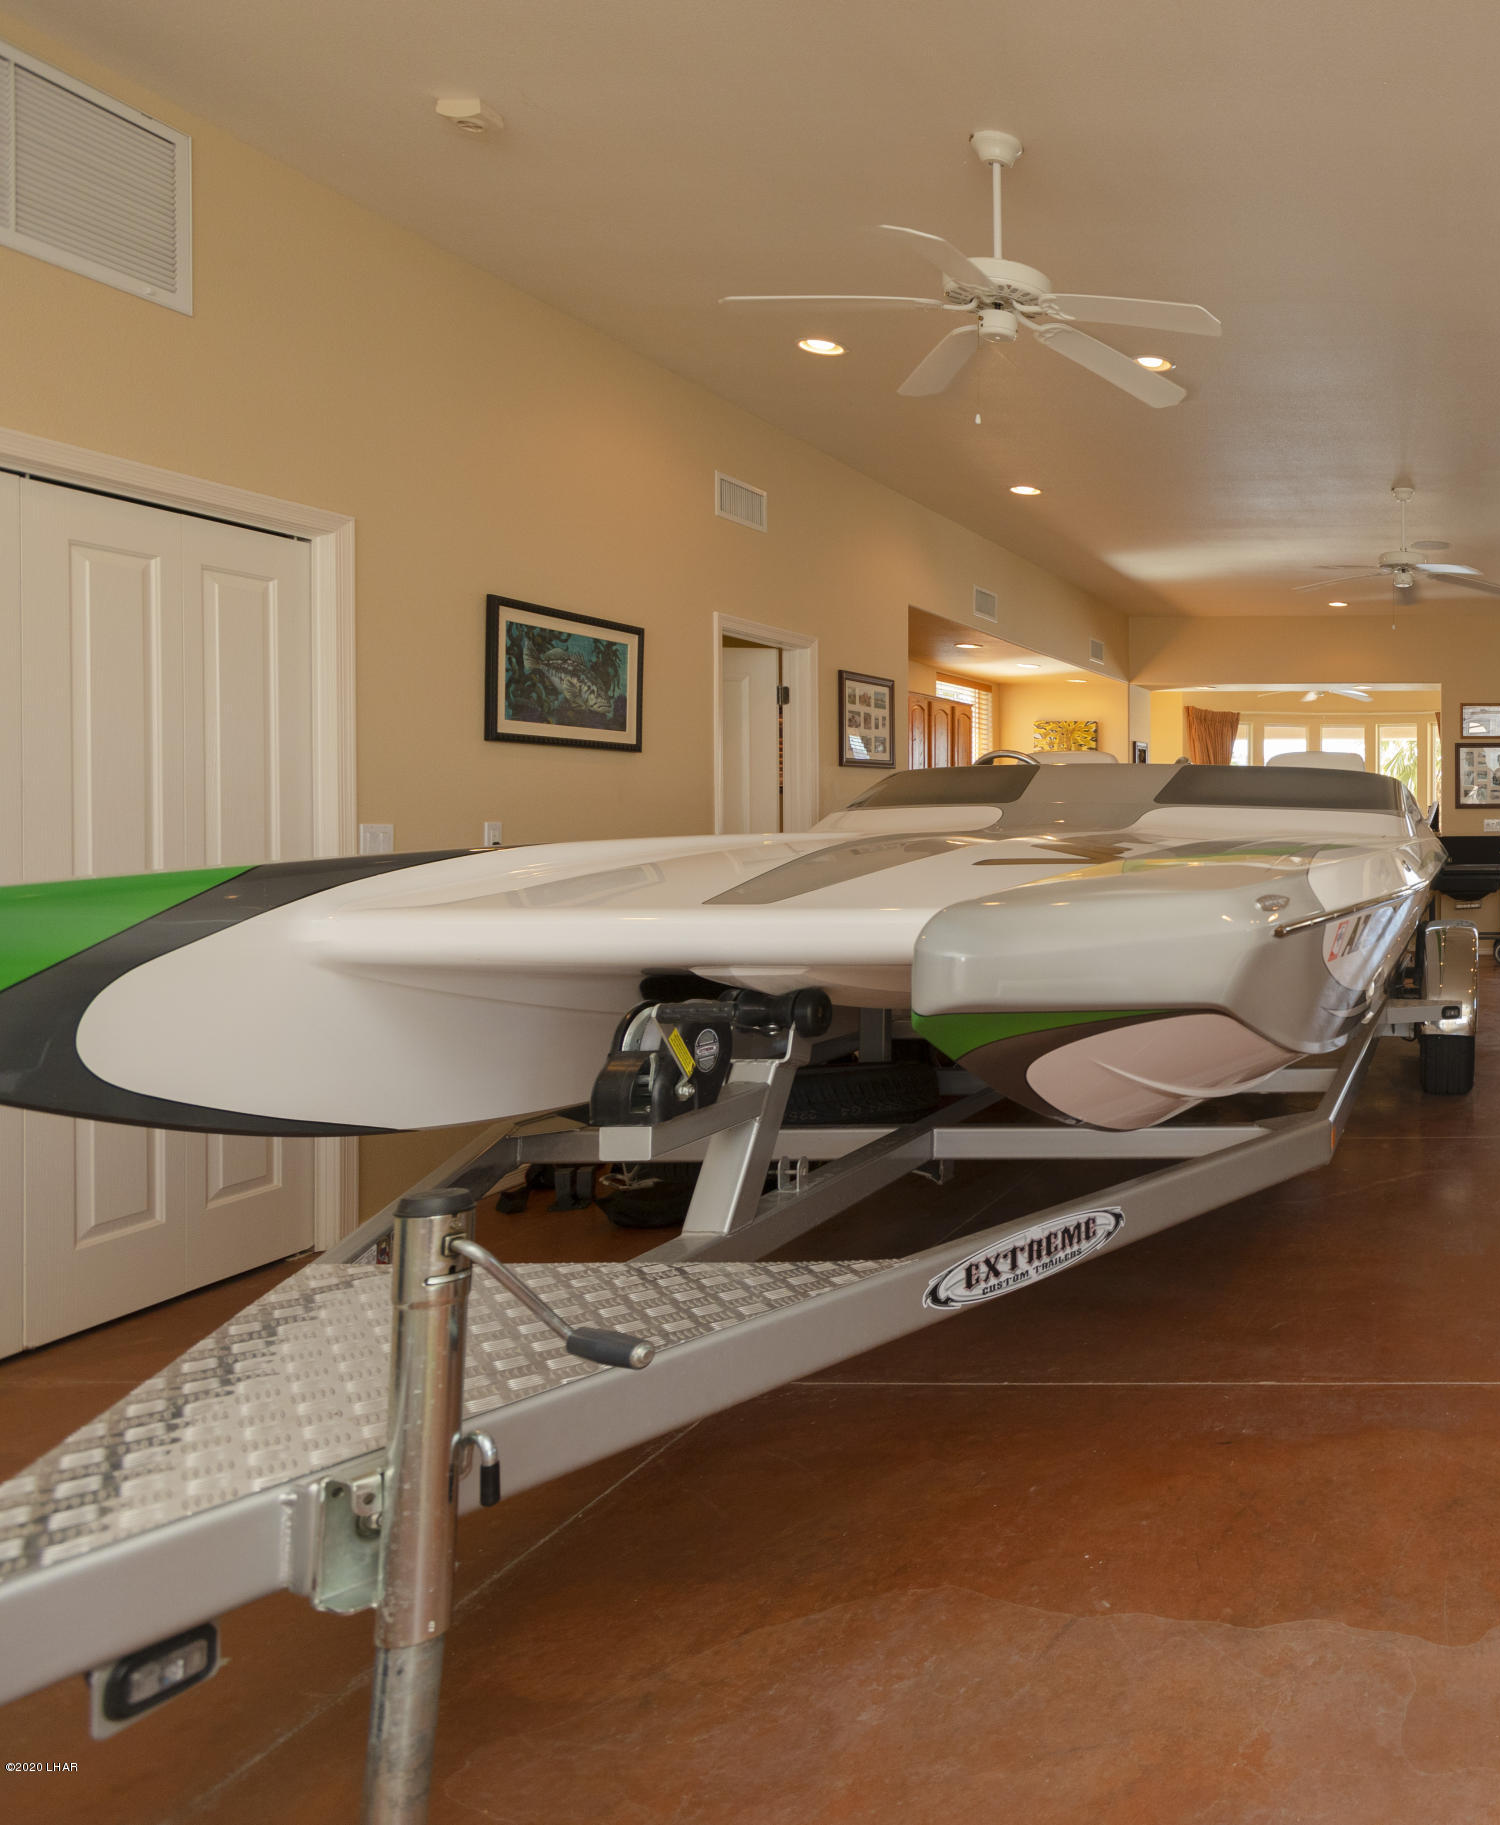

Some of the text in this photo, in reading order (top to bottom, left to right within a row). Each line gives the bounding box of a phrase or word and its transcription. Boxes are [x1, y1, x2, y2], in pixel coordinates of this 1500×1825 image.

[963, 1215, 1097, 1292] EXTREME
[982, 1247, 1083, 1296] CUSTOM TRAILERS
